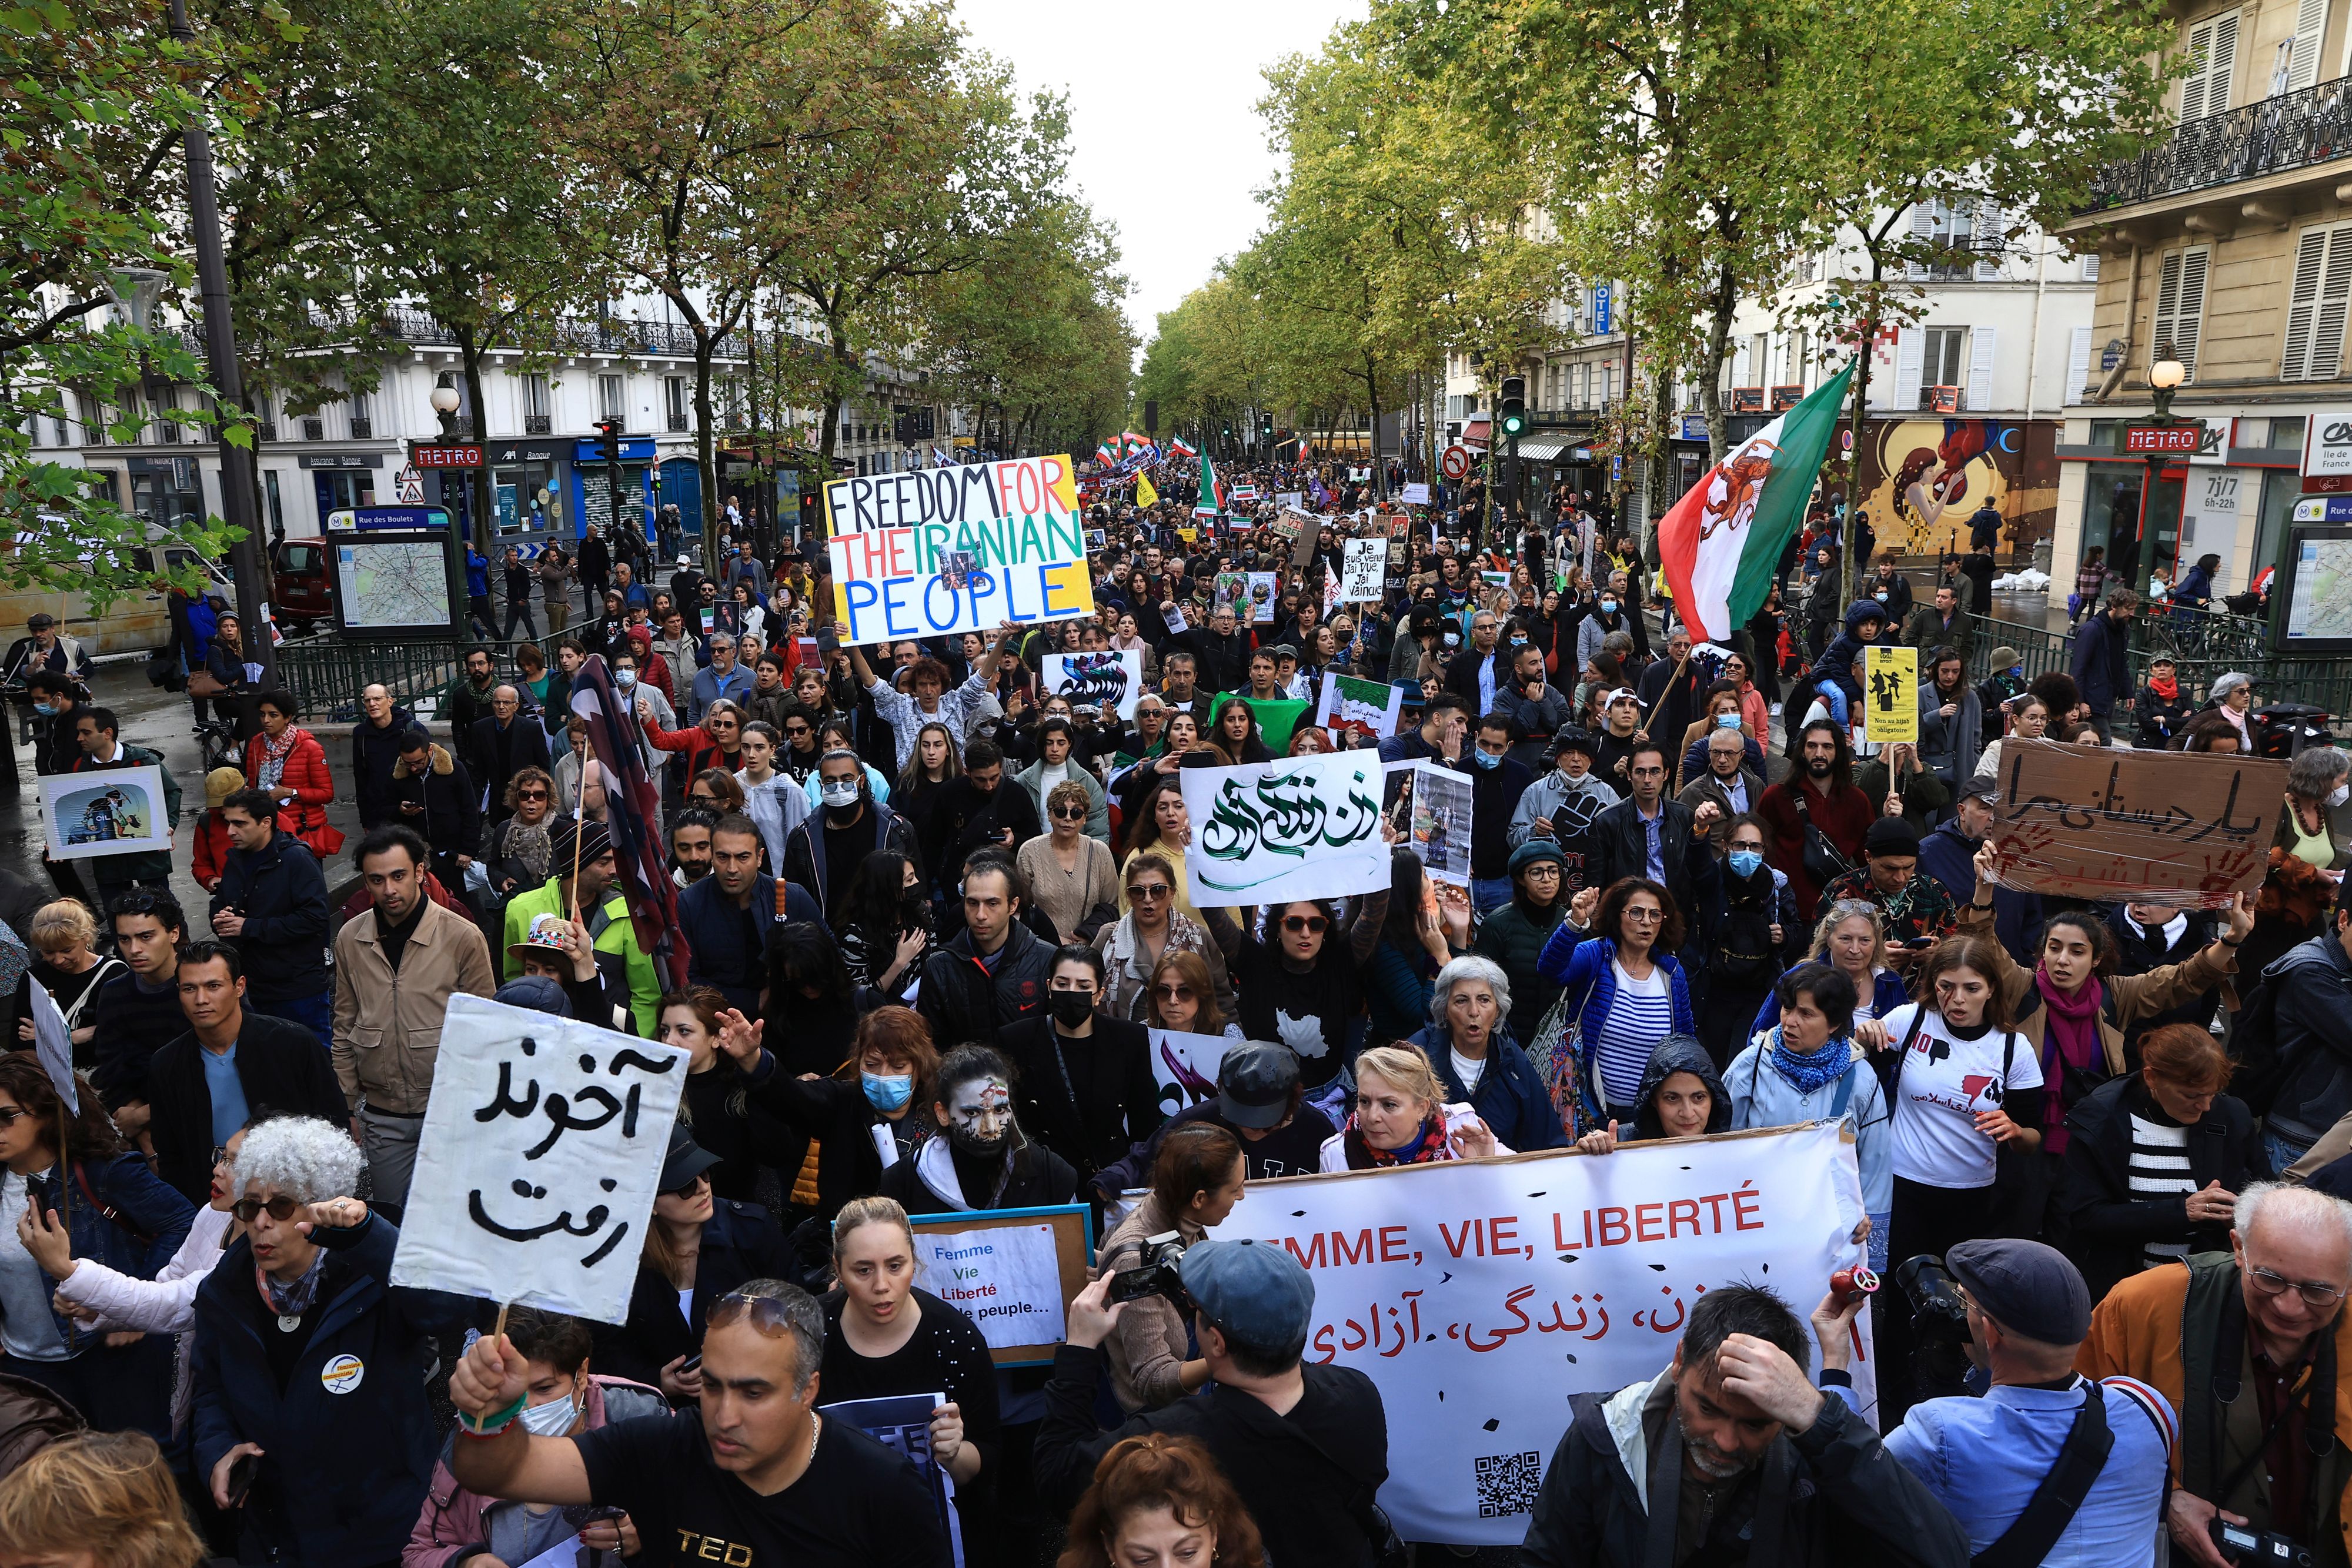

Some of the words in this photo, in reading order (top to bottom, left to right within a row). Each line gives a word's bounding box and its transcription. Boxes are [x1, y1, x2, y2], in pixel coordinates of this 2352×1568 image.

[310, 456, 336, 466] Assurance
[342, 456, 362, 466] Banque
[419, 449, 479, 464] METRO
[502, 450, 516, 460] AXA
[527, 451, 551, 460] Banque
[2130, 431, 2194, 448] METRO
[827, 464, 1000, 536] FREEDOM
[997, 459, 1070, 517] FOR
[2205, 498, 2234, 509] 6h-22h
[2207, 476, 2238, 497] 7j/7
[830, 528, 913, 582] THE
[913, 510, 1083, 574] IRANIAN
[1358, 541, 1374, 554] Je
[845, 561, 1081, 641] PEOPLE
[2006, 753, 2064, 820] مرا
[2059, 760, 2195, 834] دبستانی
[2181, 770, 2261, 844] یار
[473, 1037, 678, 1161] آخوند
[468, 1178, 629, 1268] رفت
[1263, 1225, 1423, 1271] MME,
[1438, 1215, 1534, 1261] VIE,
[1552, 1179, 1765, 1252] LIBERTÉ
[935, 1245, 993, 1261] Femme
[952, 1267, 979, 1281] Vie
[941, 1283, 997, 1300] Liberté
[1313, 1288, 1424, 1365] آزادی
[1446, 1284, 1611, 1353] زندگی،
[677, 1528, 753, 1568] TED
